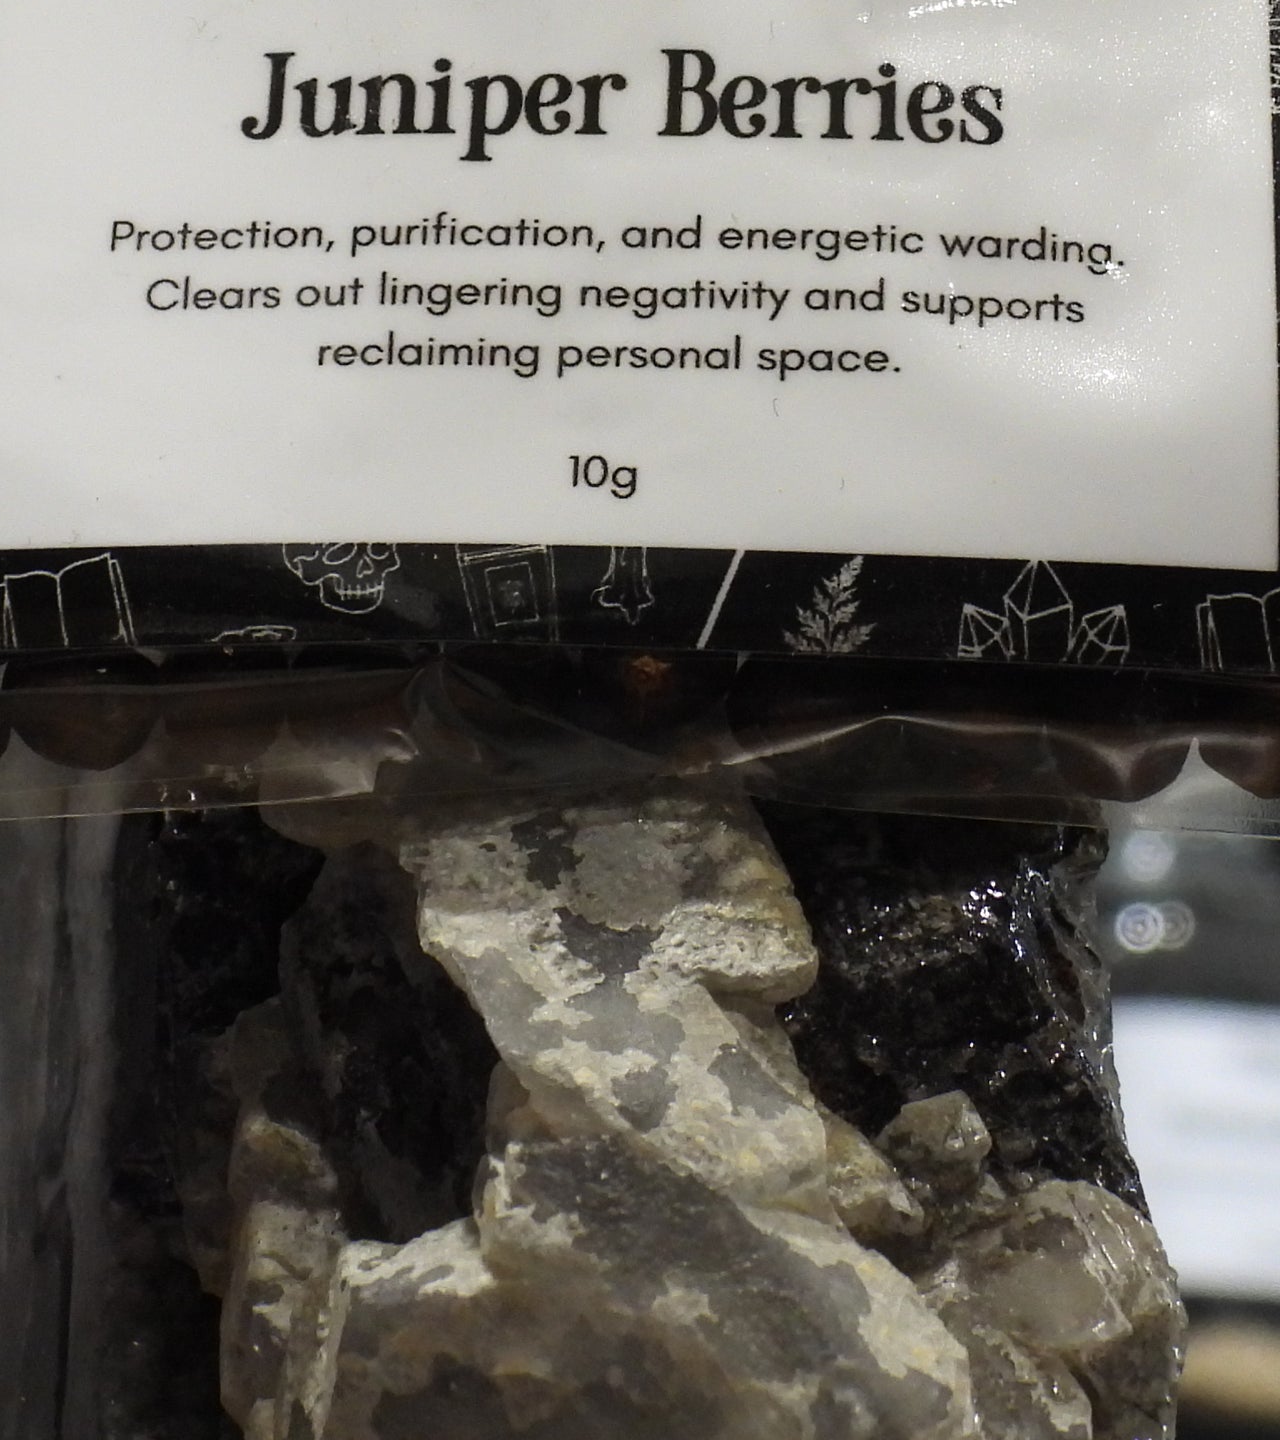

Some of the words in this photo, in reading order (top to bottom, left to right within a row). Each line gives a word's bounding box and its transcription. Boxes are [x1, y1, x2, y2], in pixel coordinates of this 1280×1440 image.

[240, 51, 628, 163] Juniper
[656, 48, 1004, 146] Berries
[110, 220, 335, 257] Protection,
[350, 211, 606, 257] purification,
[621, 215, 702, 251] and
[717, 220, 924, 262] energetic
[939, 226, 1125, 275] warding.
[146, 275, 281, 311] Clears
[295, 277, 365, 308] out
[379, 271, 562, 318] lingering
[579, 280, 791, 321] negativity
[804, 277, 885, 312] and
[900, 286, 1086, 329] supports
[317, 331, 540, 379] reclaiming
[557, 334, 742, 379] personal
[756, 348, 901, 382] space.
[568, 454, 638, 500] 10g
